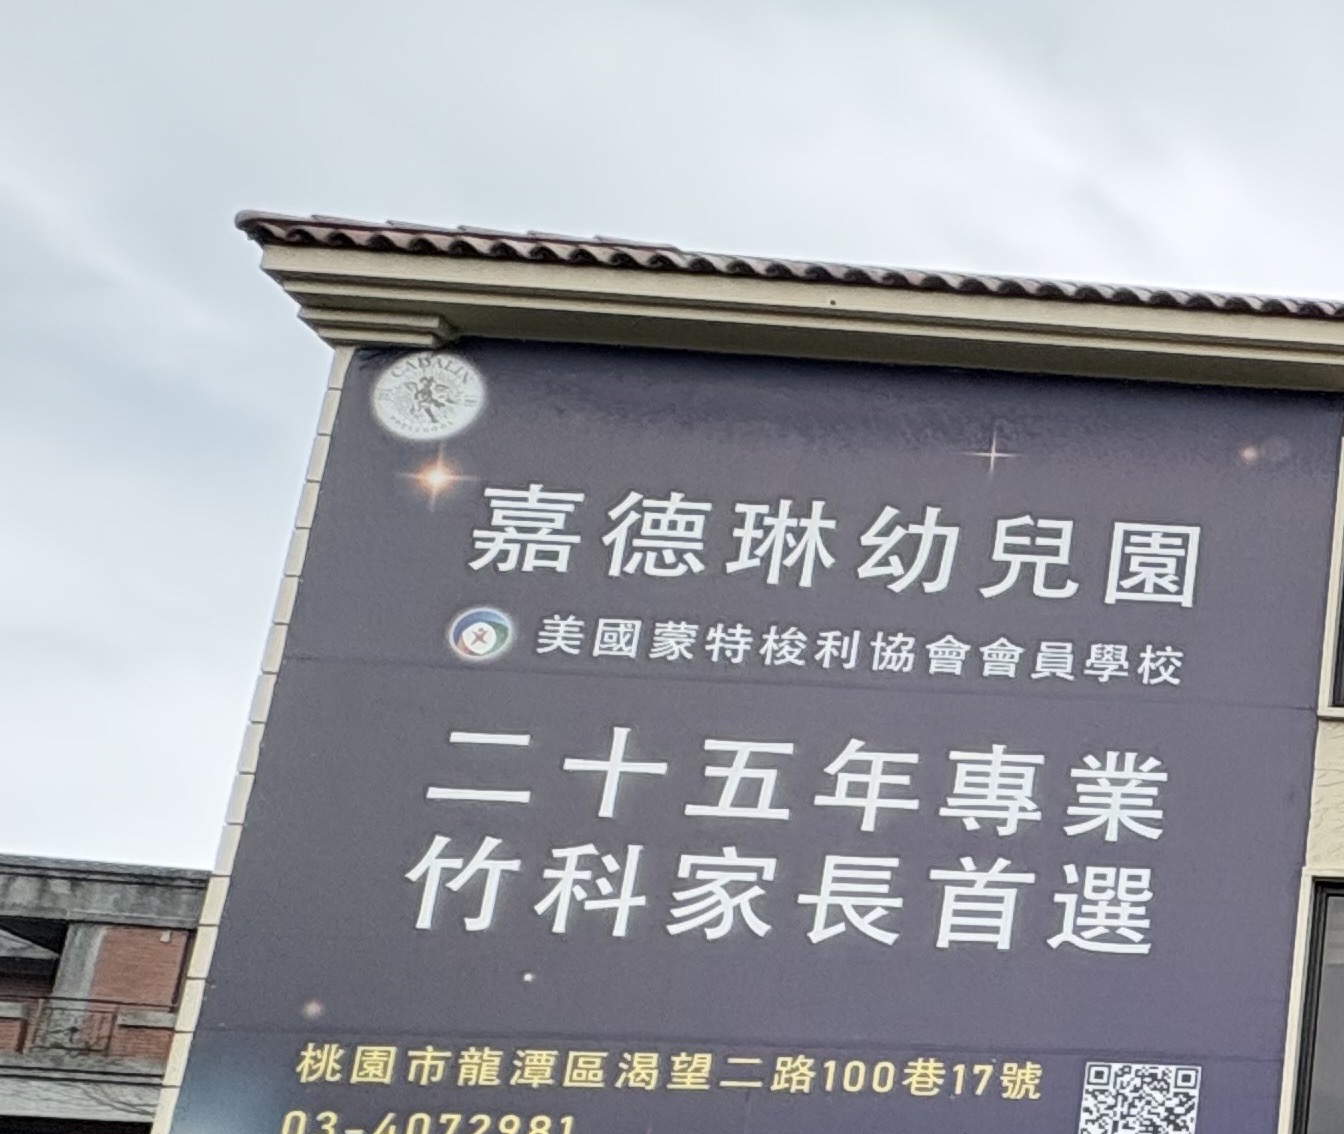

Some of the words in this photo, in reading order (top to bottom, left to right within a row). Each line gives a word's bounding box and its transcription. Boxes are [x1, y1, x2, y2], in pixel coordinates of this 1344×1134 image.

[468, 482, 1202, 608] 嘉德琳幼兒園
[535, 614, 1185, 687] 美國蒙特梭利協會會員學校
[425, 726, 1169, 843] 二十五年專業
[405, 835, 1154, 956] 竹科家長首選
[294, 1042, 1044, 1102] 桃園市龍潭區渴望二路100巷17號
